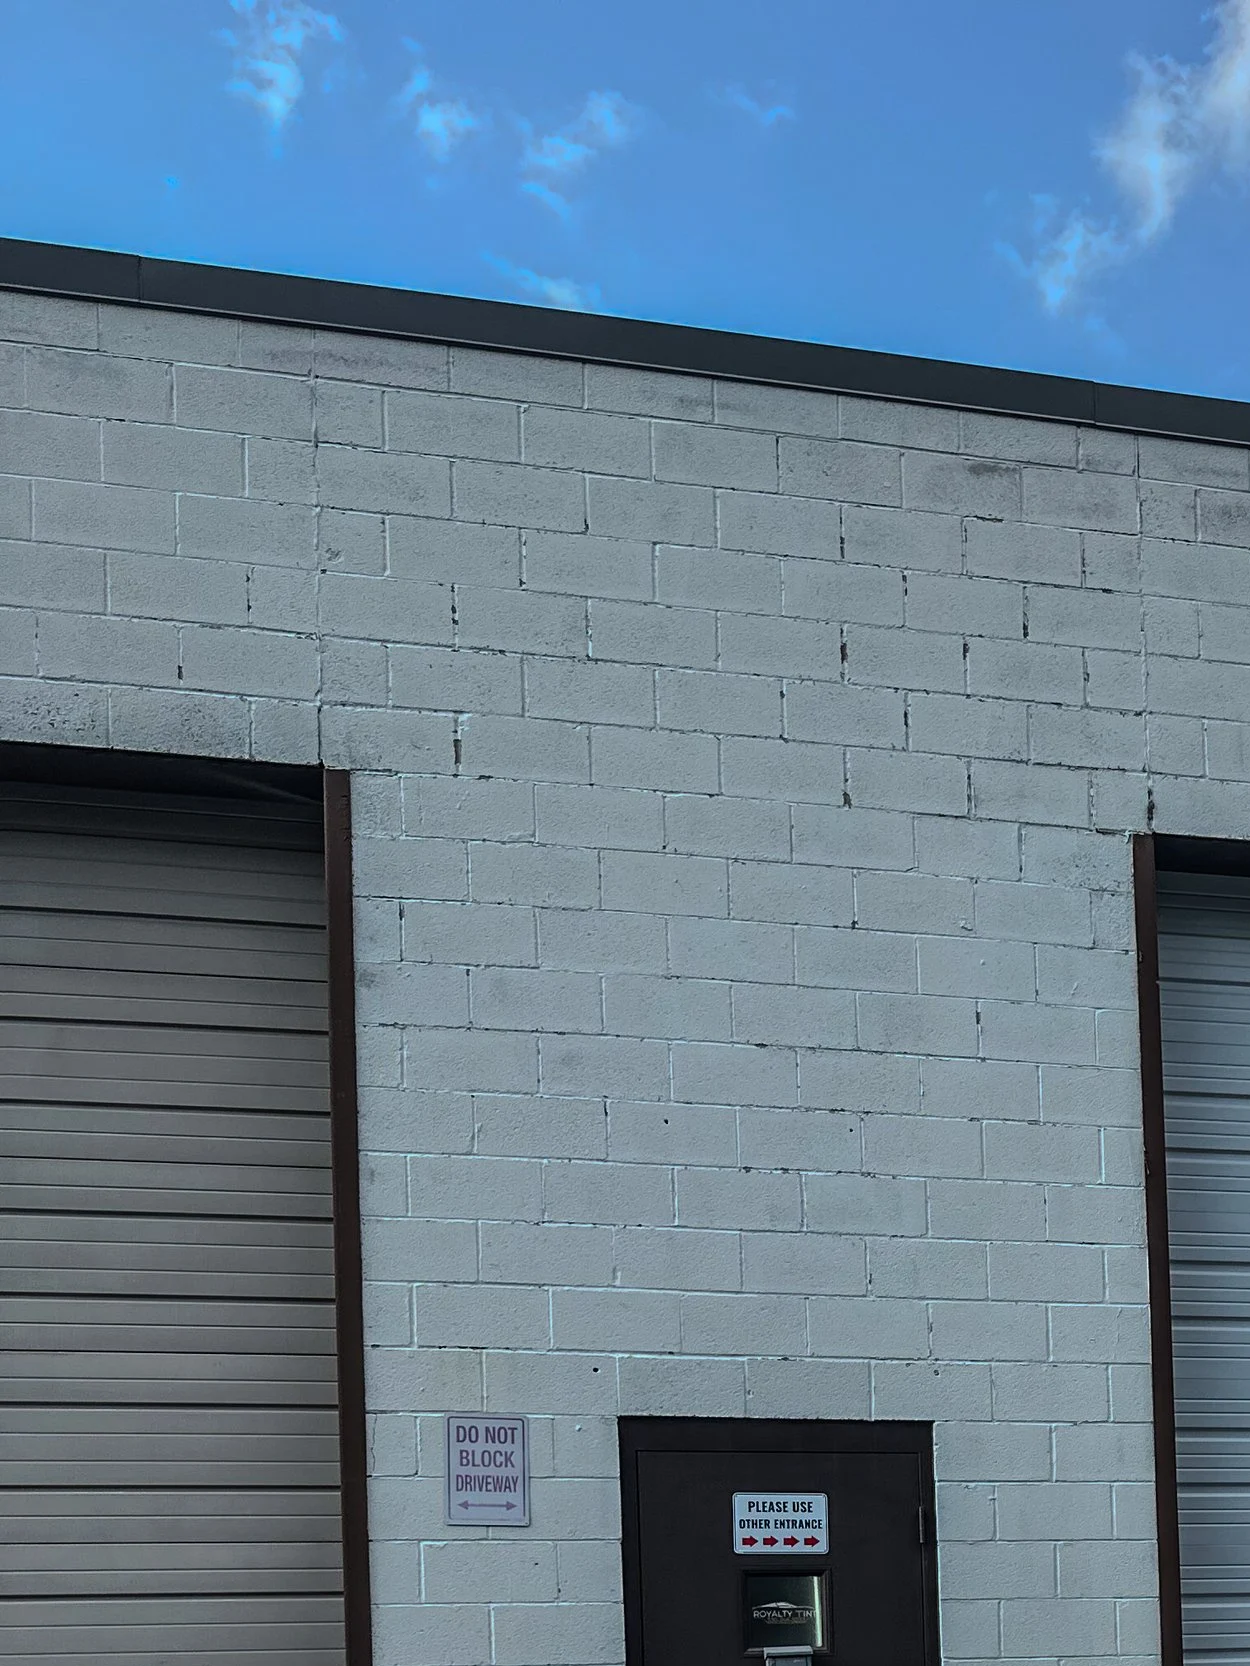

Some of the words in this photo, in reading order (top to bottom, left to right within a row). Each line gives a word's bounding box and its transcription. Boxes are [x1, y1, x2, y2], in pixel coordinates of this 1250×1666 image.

[456, 1425, 479, 1443] DO
[485, 1426, 518, 1444] NOT
[459, 1449, 515, 1468] BLOCK
[456, 1474, 519, 1493] DRIVEWAY
[748, 1501, 788, 1513] PLEASE
[792, 1501, 813, 1513] USE
[739, 1519, 770, 1529] OTHER
[774, 1519, 823, 1529] ENTRANCE
[753, 1610, 792, 1618] ROYALTY
